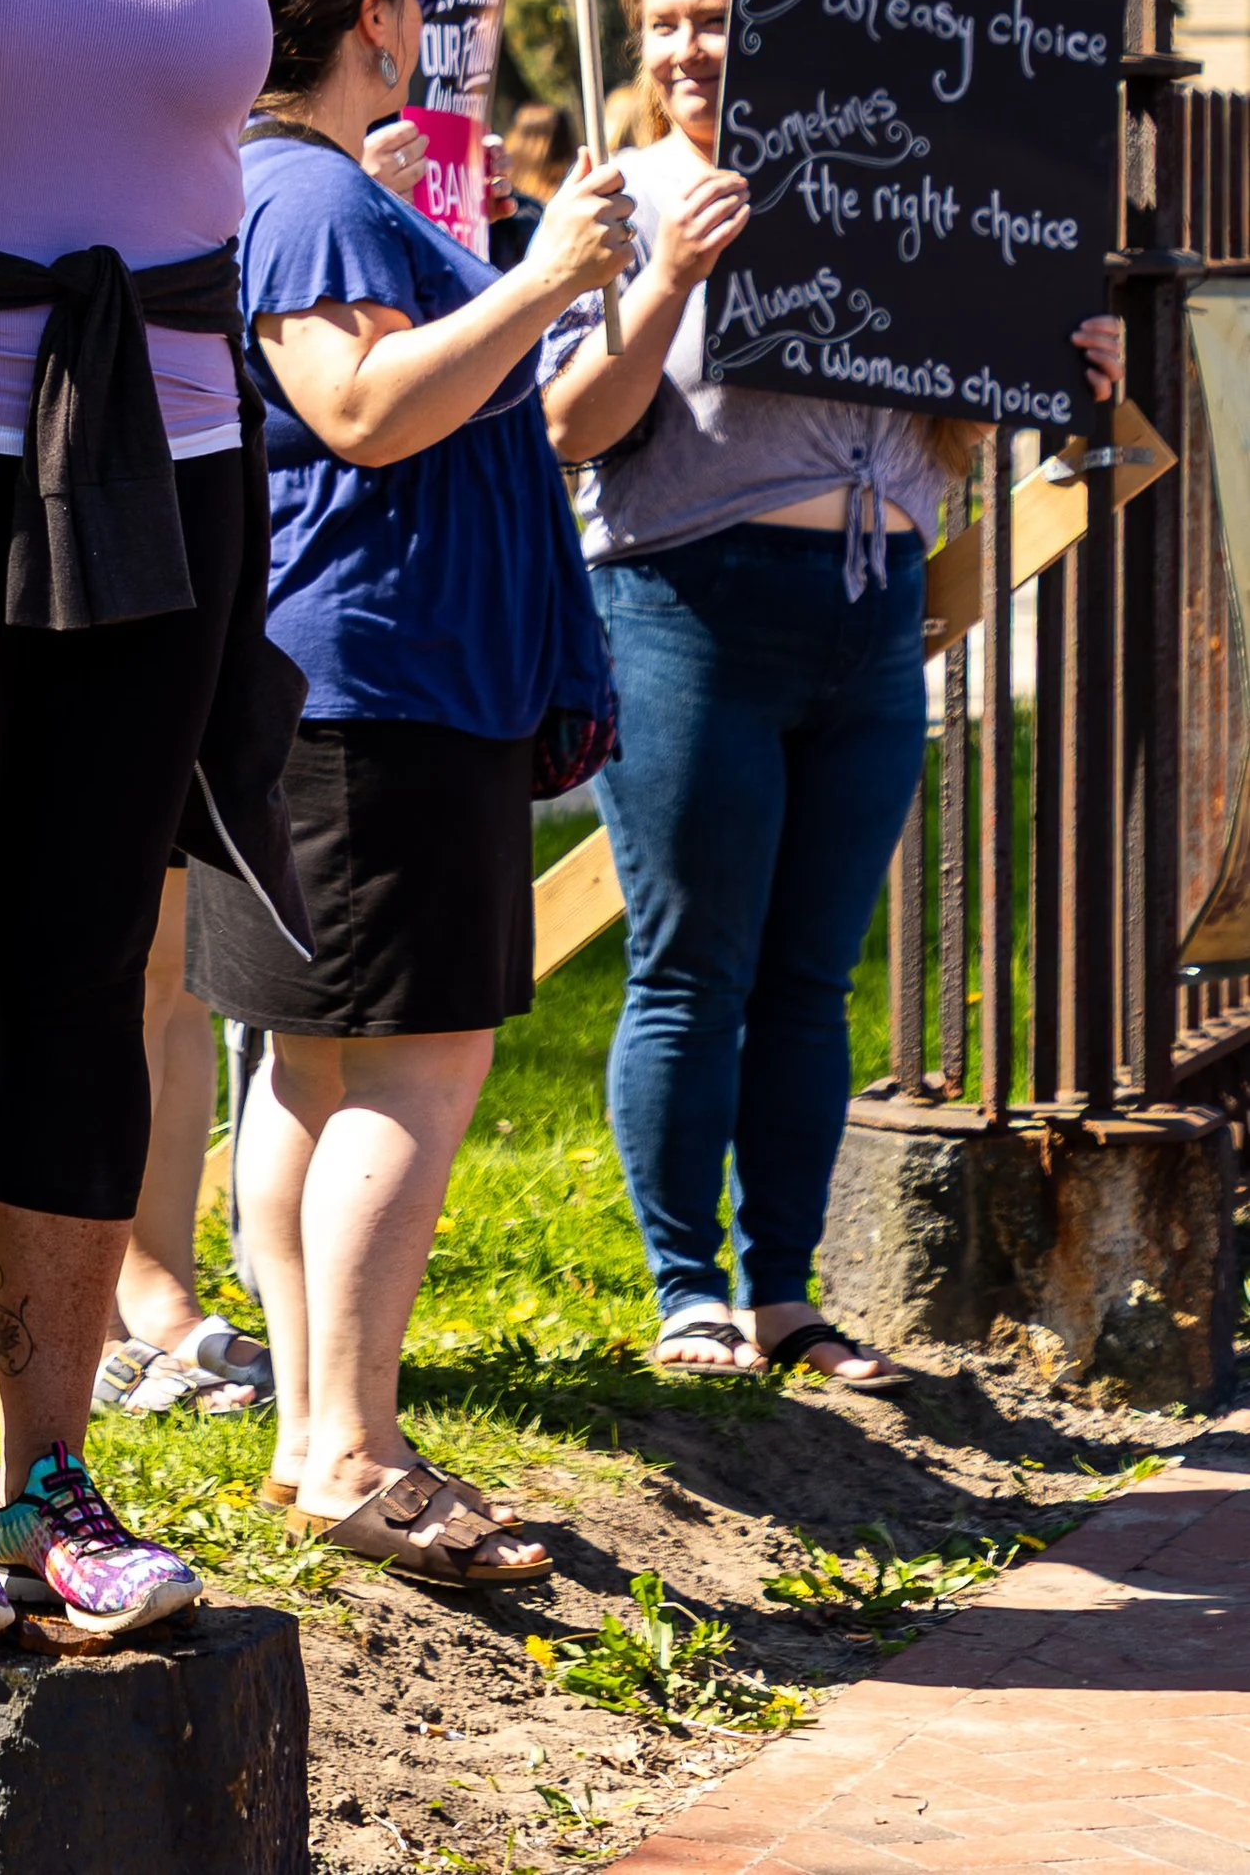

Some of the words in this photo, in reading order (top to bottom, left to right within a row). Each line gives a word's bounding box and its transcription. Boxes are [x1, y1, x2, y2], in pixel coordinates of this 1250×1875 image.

[420, 23, 461, 77] OUR
[727, 87, 899, 175] Sometimes
[797, 163, 861, 236] the
[873, 174, 960, 263] right
[971, 188, 1079, 266] choice
[716, 266, 842, 335] Always
[782, 340, 812, 375] a
[961, 365, 1072, 424] choice
